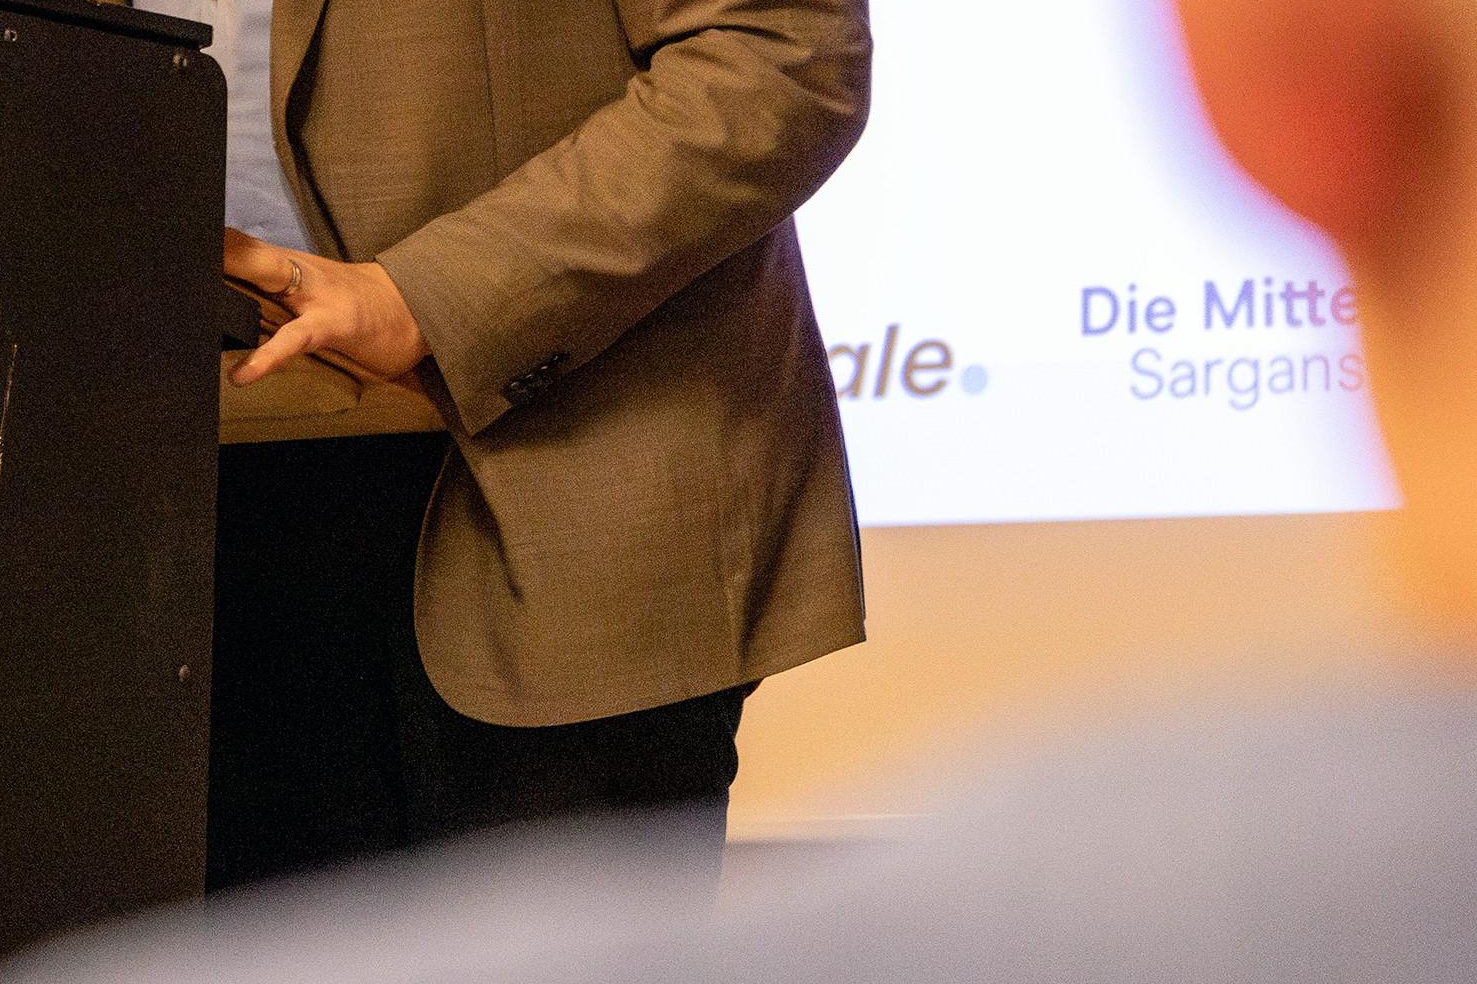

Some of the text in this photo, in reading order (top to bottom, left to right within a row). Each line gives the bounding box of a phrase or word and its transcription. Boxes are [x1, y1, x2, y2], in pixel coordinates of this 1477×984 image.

[1081, 276, 1358, 337] Die Mitte
[1130, 347, 1364, 411] Sargans
